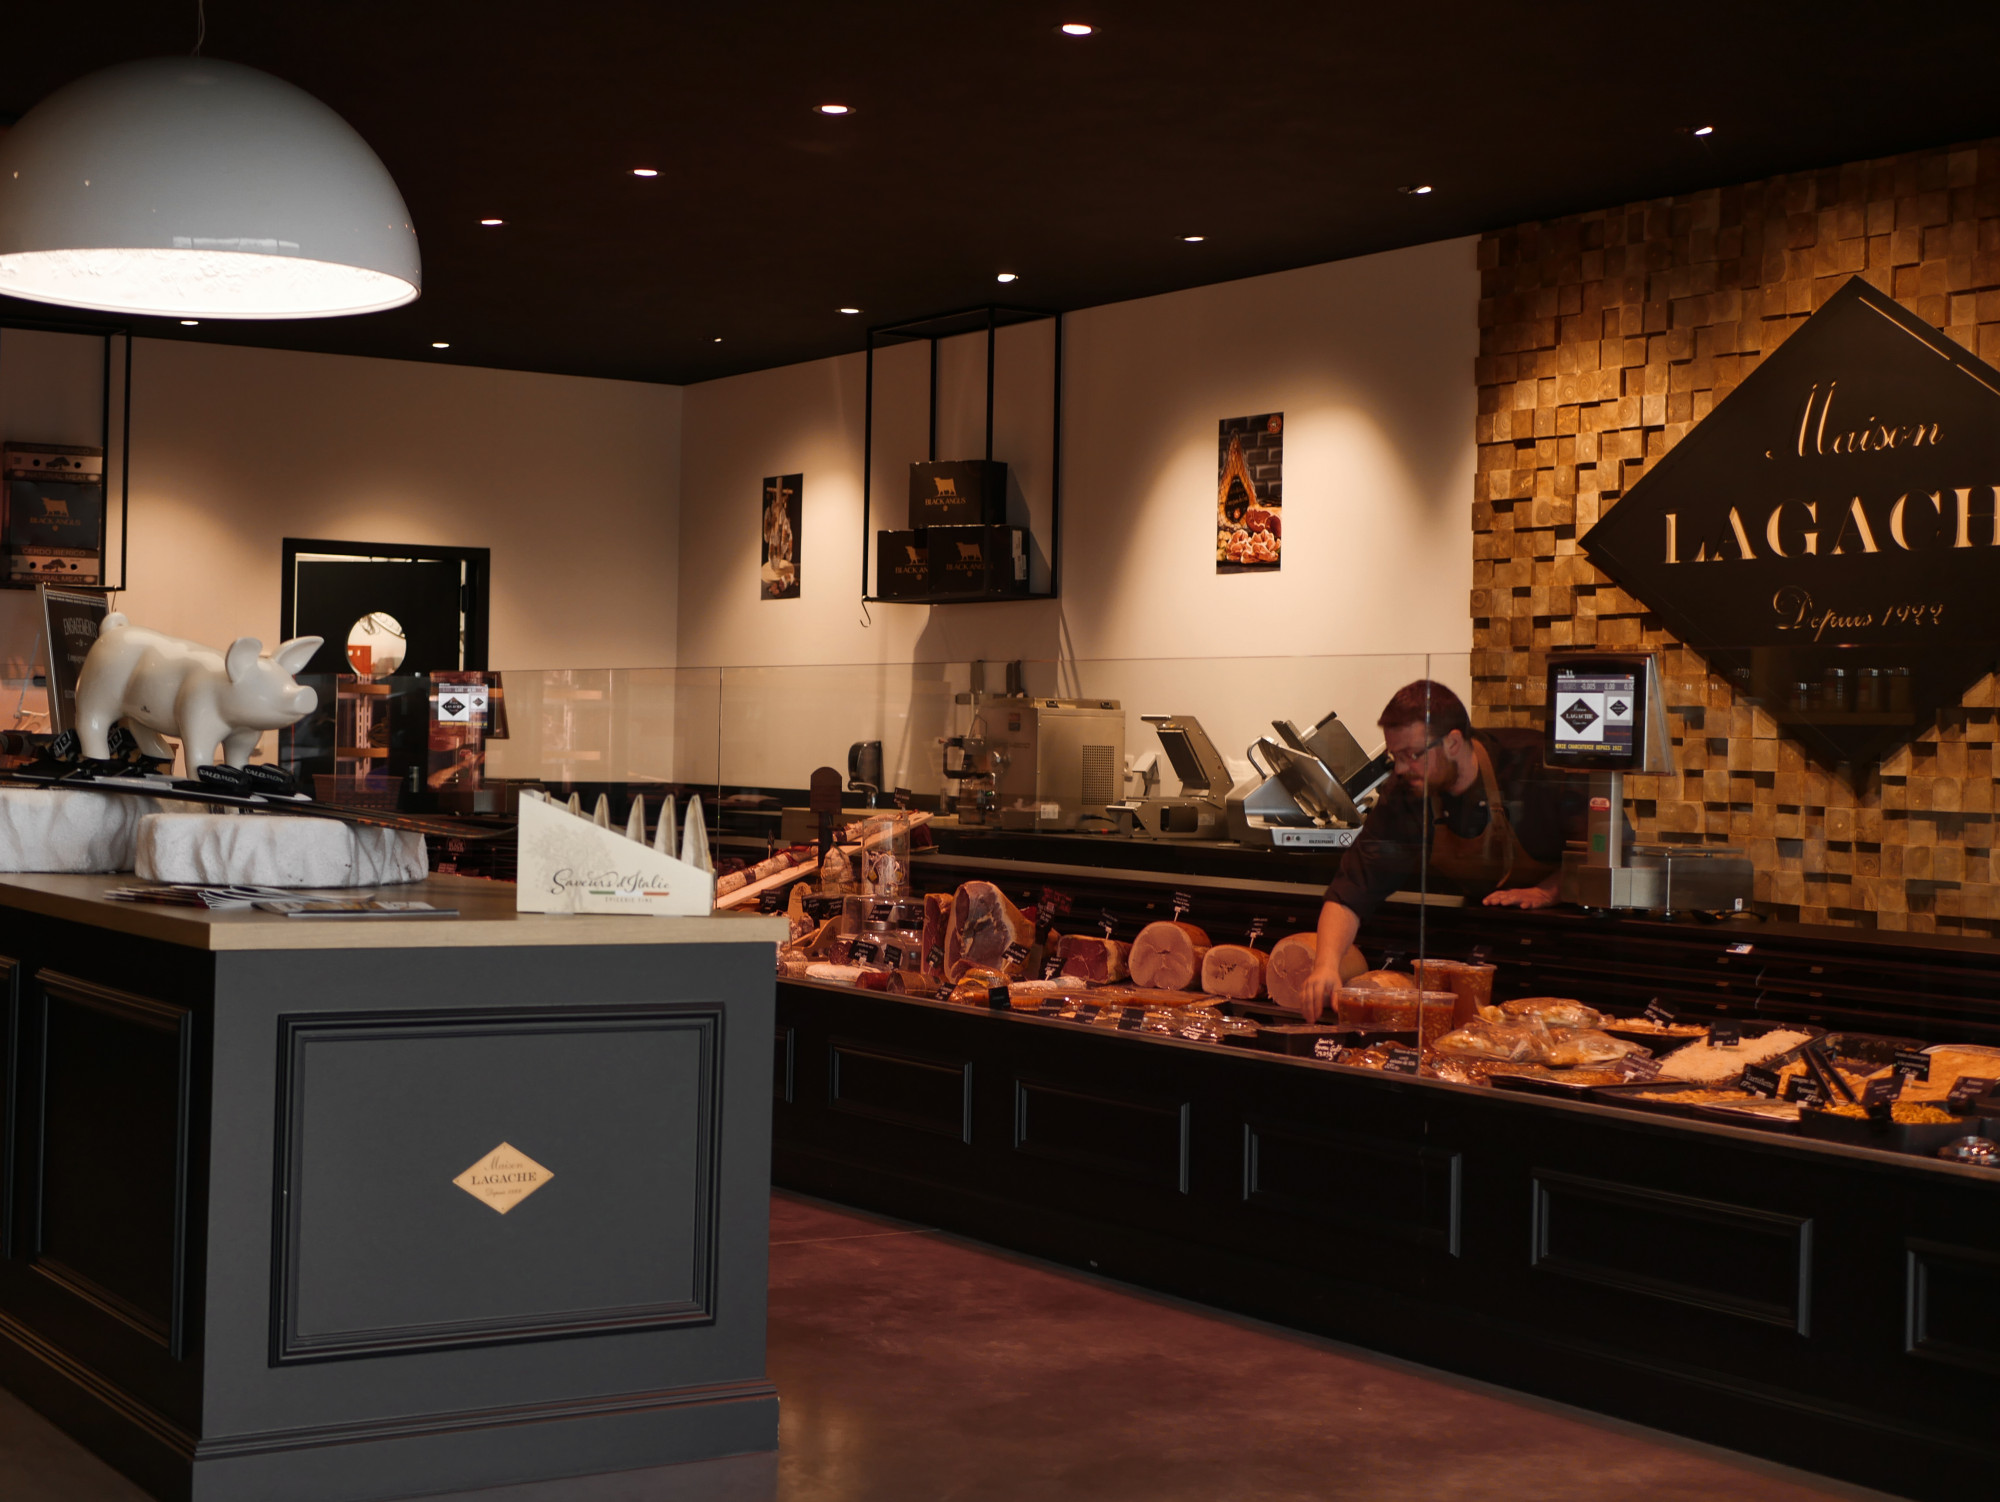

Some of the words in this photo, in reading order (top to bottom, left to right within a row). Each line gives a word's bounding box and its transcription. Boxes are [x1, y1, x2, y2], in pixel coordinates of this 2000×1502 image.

[1766, 381, 1944, 459] Maison
[925, 497, 944, 505] BLACK
[945, 496, 966, 504] ANGUS
[29, 517, 52, 525] BLACK
[22, 547, 51, 555] CERDO
[895, 565, 915, 574] BLACK
[945, 563, 968, 571] BLACK
[61, 575, 84, 583] MEAT
[1773, 585, 1873, 642] Depuis
[63, 617, 98, 639] ENGAGEMENTS
[198, 769, 240, 785] SALOMON
[244, 768, 285, 784] SALOMON
[550, 868, 612, 894] Saveurs
[484, 1155, 524, 1170] Maison
[471, 1171, 537, 1186] LAGACHE
